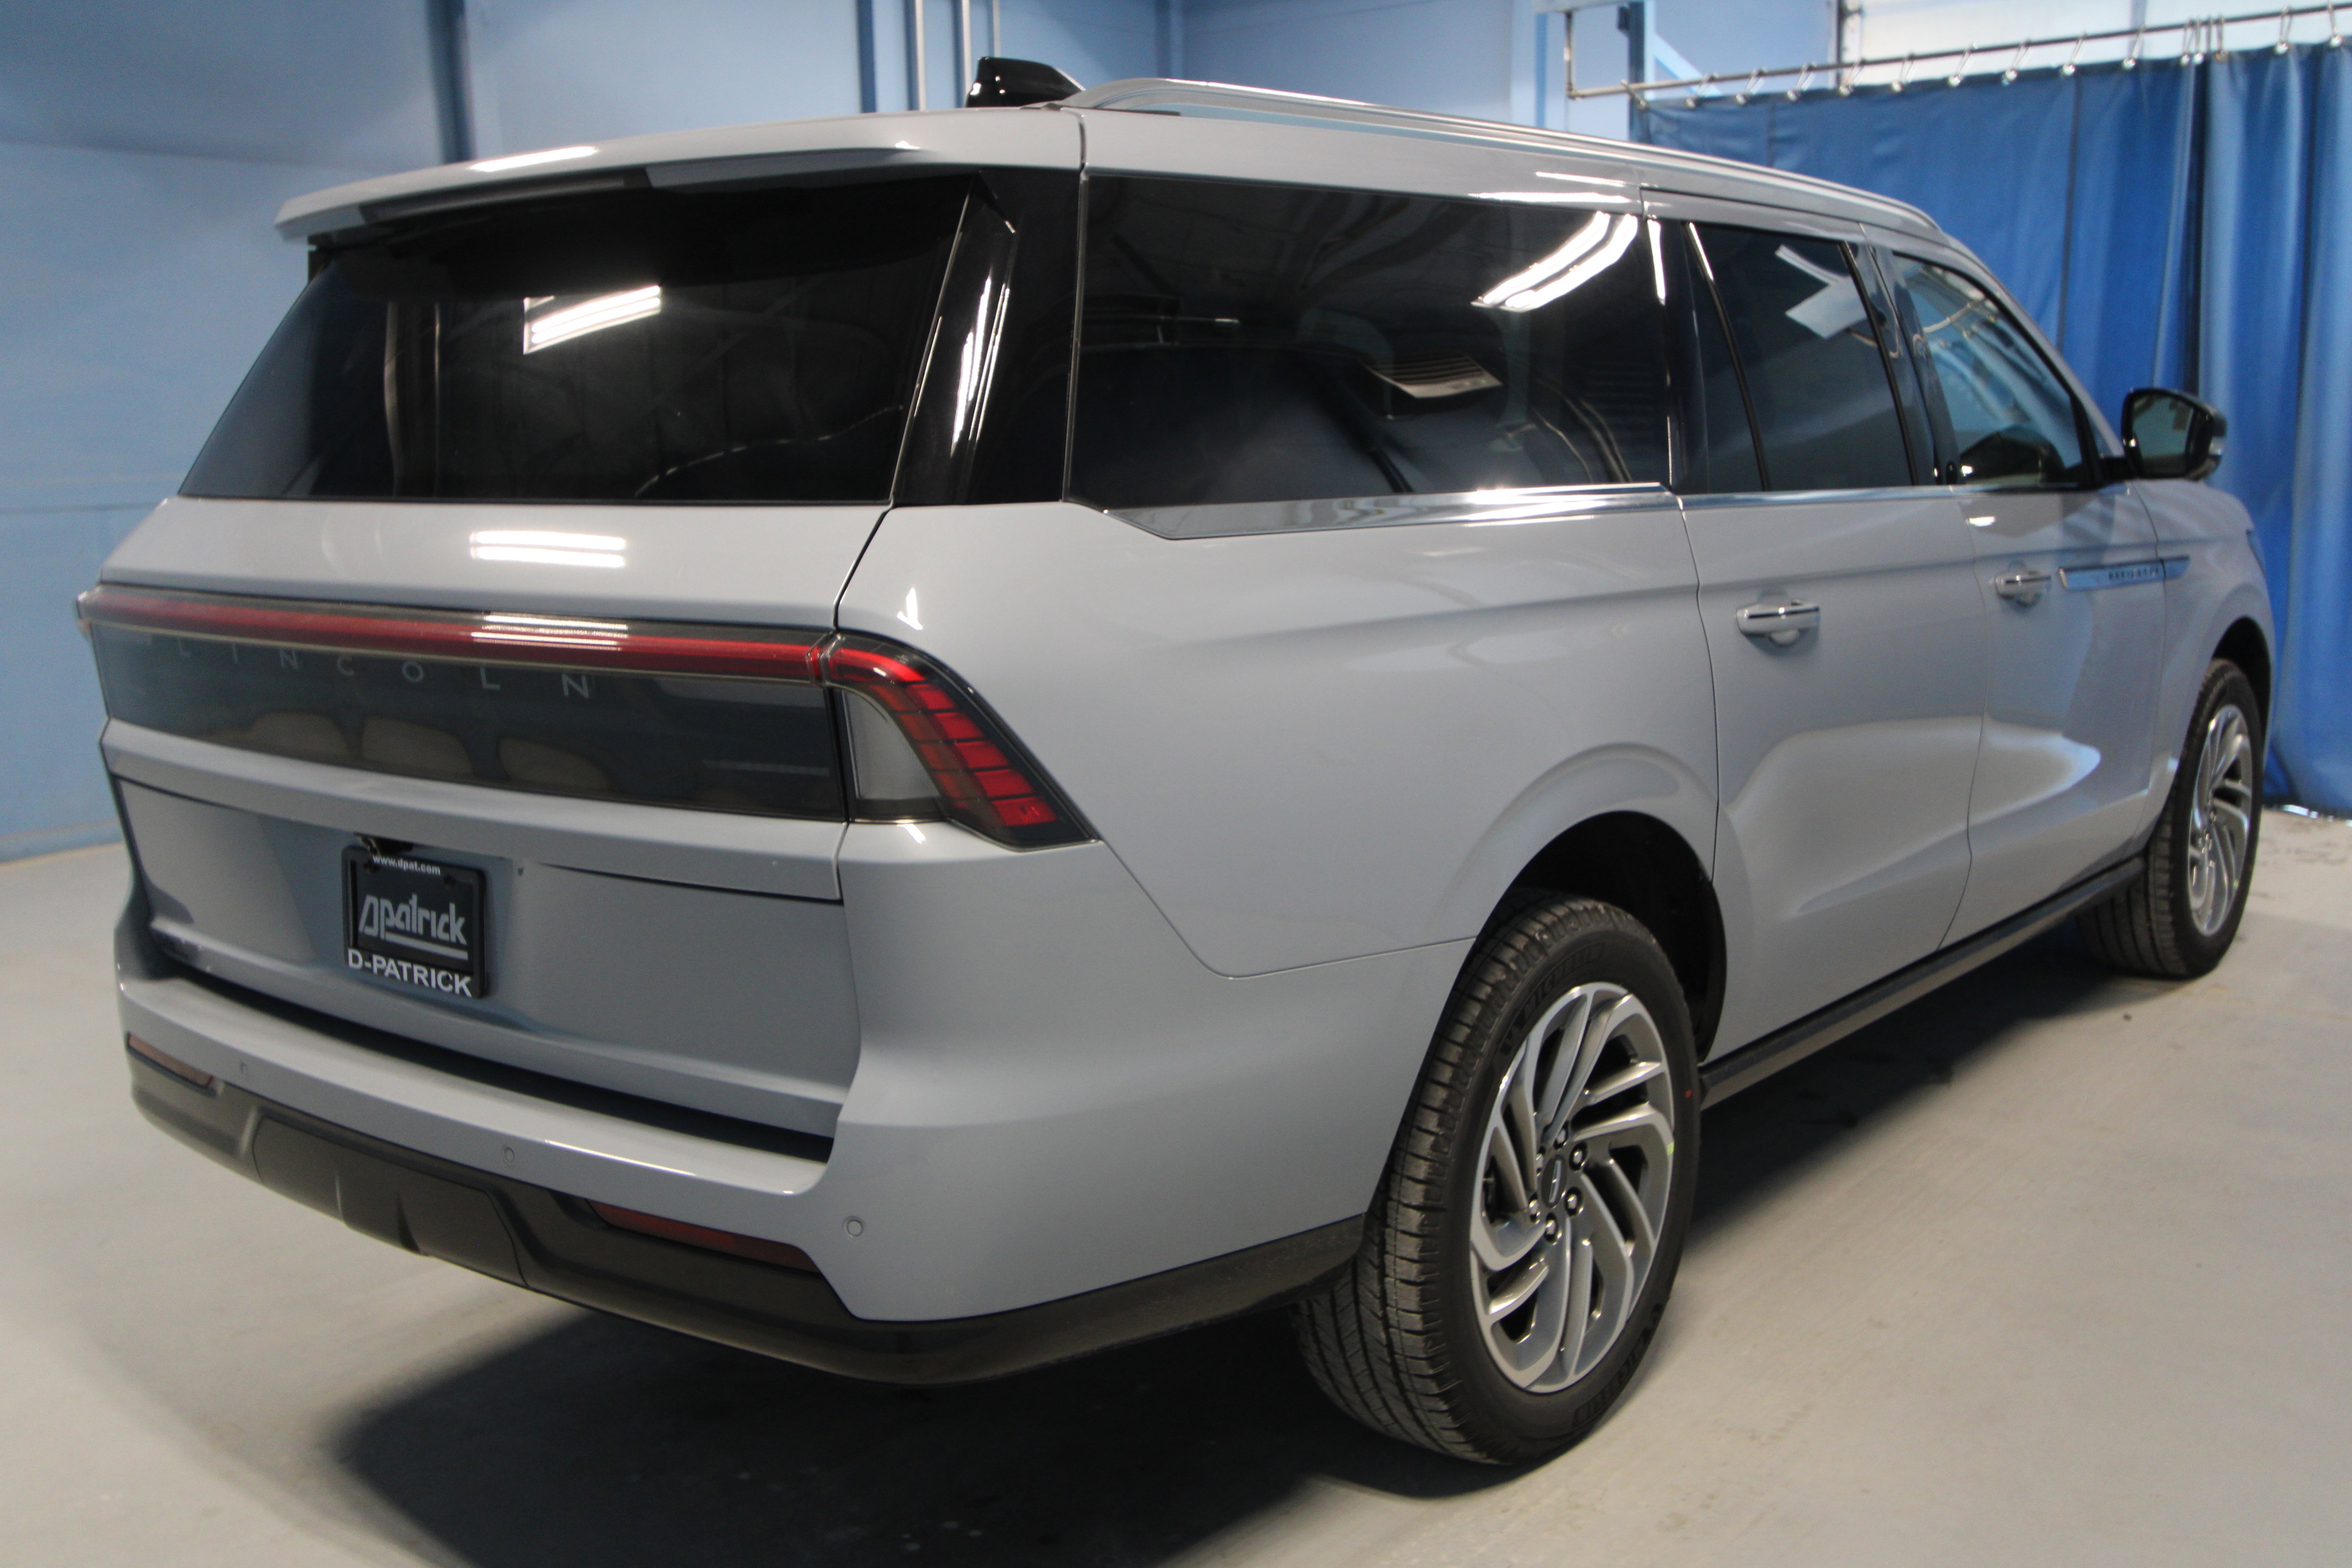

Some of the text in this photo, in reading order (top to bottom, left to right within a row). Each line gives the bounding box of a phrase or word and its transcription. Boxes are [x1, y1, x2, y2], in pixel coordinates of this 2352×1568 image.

[177, 636, 589, 698] LINCOLN
[372, 855, 441, 876] www.dpat.com
[347, 948, 472, 998] D-PATRICK
